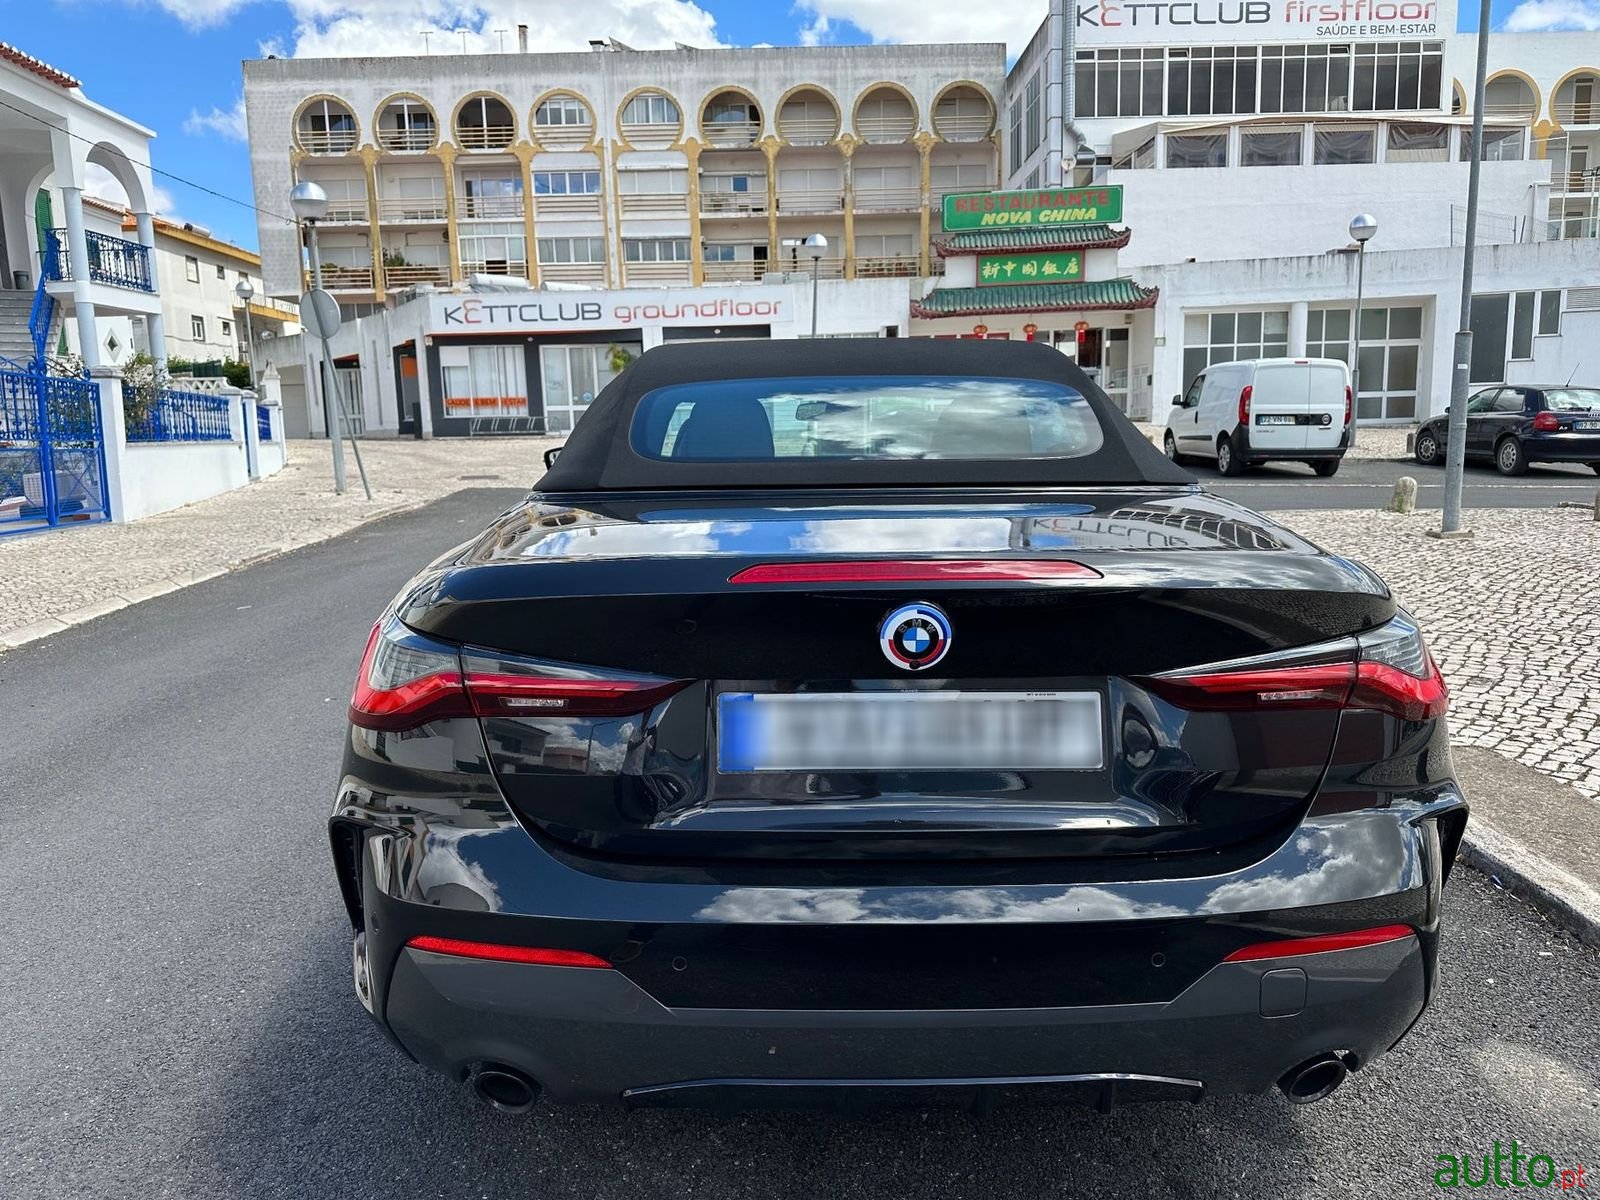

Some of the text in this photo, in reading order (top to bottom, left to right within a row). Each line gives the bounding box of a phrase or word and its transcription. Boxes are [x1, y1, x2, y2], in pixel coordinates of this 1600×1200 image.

[1285, 0, 1436, 23] firstfloor
[1316, 23, 1436, 36] SAÚDE E BEM-ESTAR
[955, 190, 1111, 213] RESTAURANTE
[981, 207, 1097, 226] NOVA CHINA
[444, 299, 782, 325] KETTCLUB groundfloor
[897, 618, 937, 633] BMW
